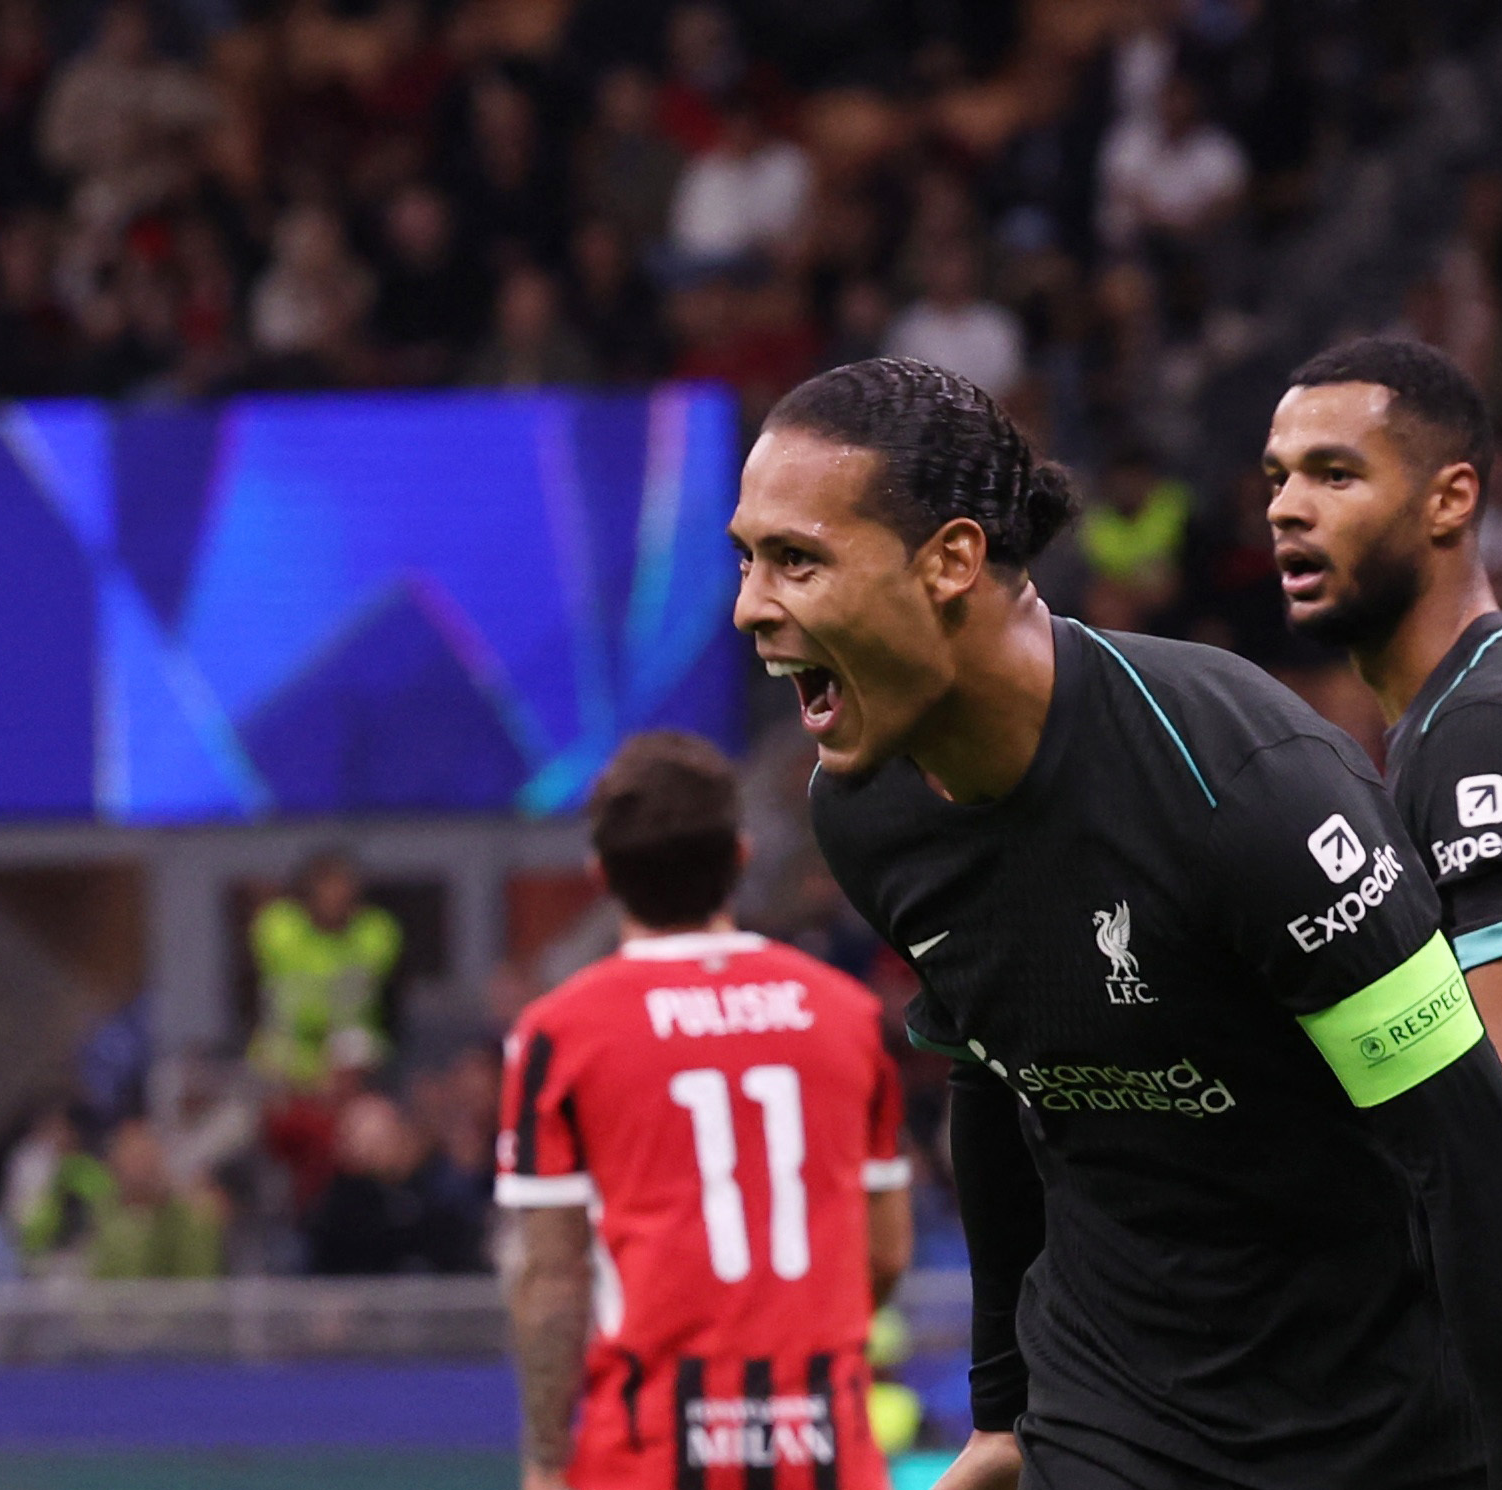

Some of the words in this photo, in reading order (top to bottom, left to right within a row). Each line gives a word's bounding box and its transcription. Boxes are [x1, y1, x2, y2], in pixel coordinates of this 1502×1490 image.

[645, 979, 816, 1041] PULISIC
[1388, 978, 1466, 1046] RESPECT
[668, 1064, 811, 1284] 11
[687, 1423, 835, 1467] MILAN
